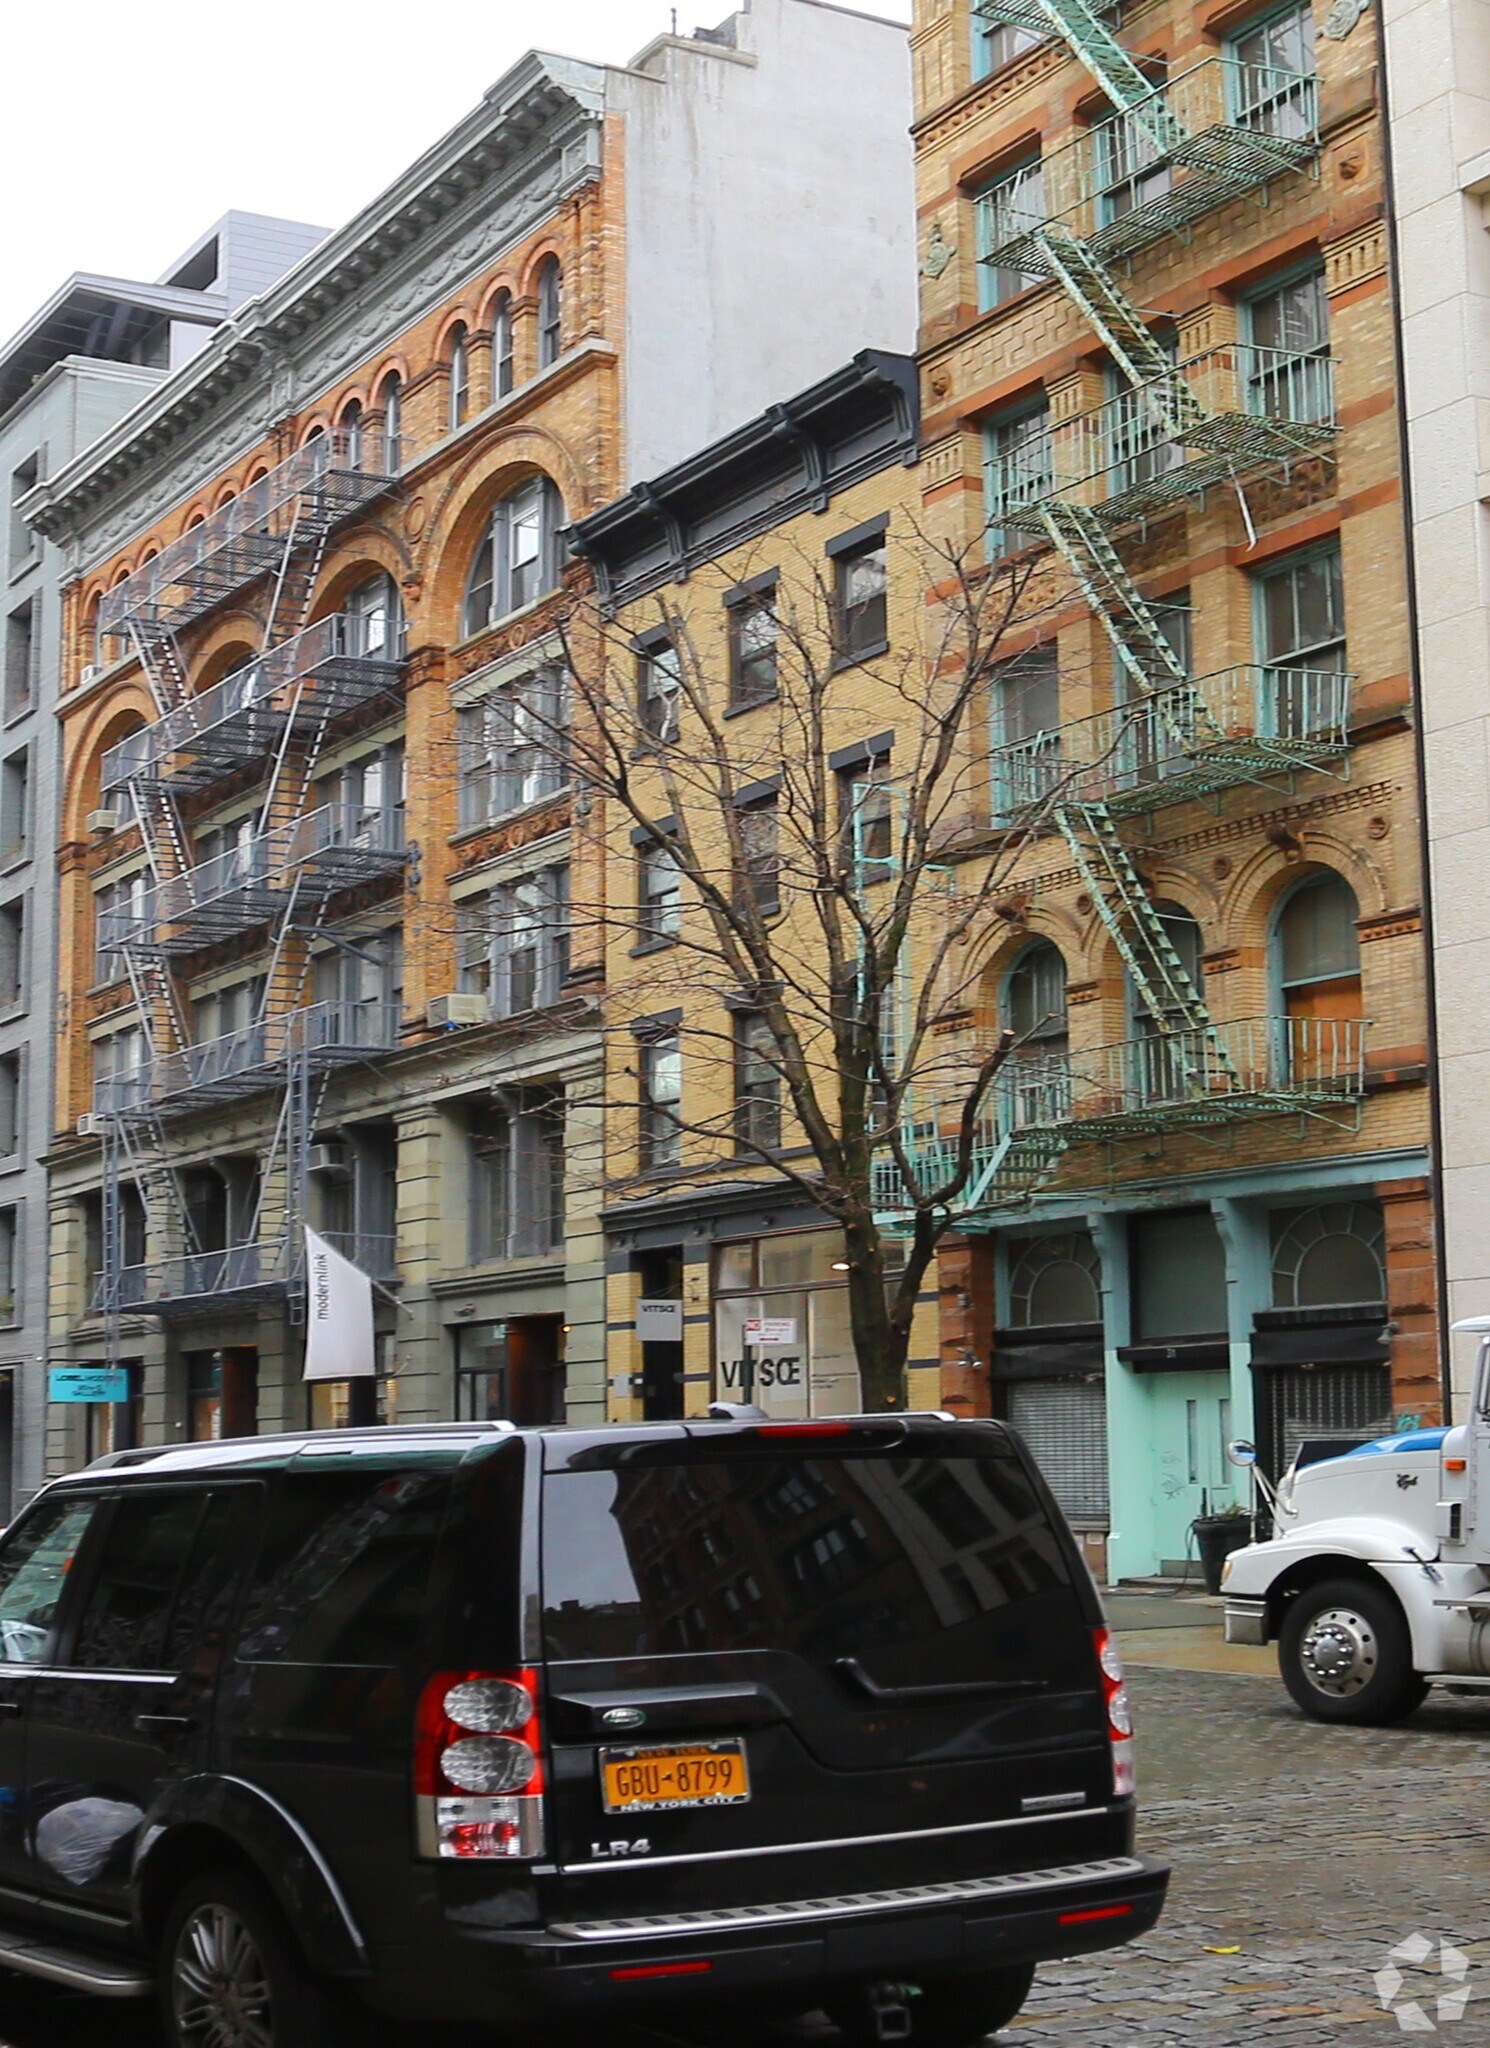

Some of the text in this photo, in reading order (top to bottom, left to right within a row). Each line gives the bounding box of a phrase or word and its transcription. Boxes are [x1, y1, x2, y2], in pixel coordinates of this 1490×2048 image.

[313, 1253, 329, 1320] modernlink
[616, 1758, 732, 1797] GBU 8799
[620, 1802, 656, 1812] NEW
[659, 1799, 698, 1810] YORK
[703, 1796, 736, 1806] CITY
[591, 1838, 651, 1858] LR4
